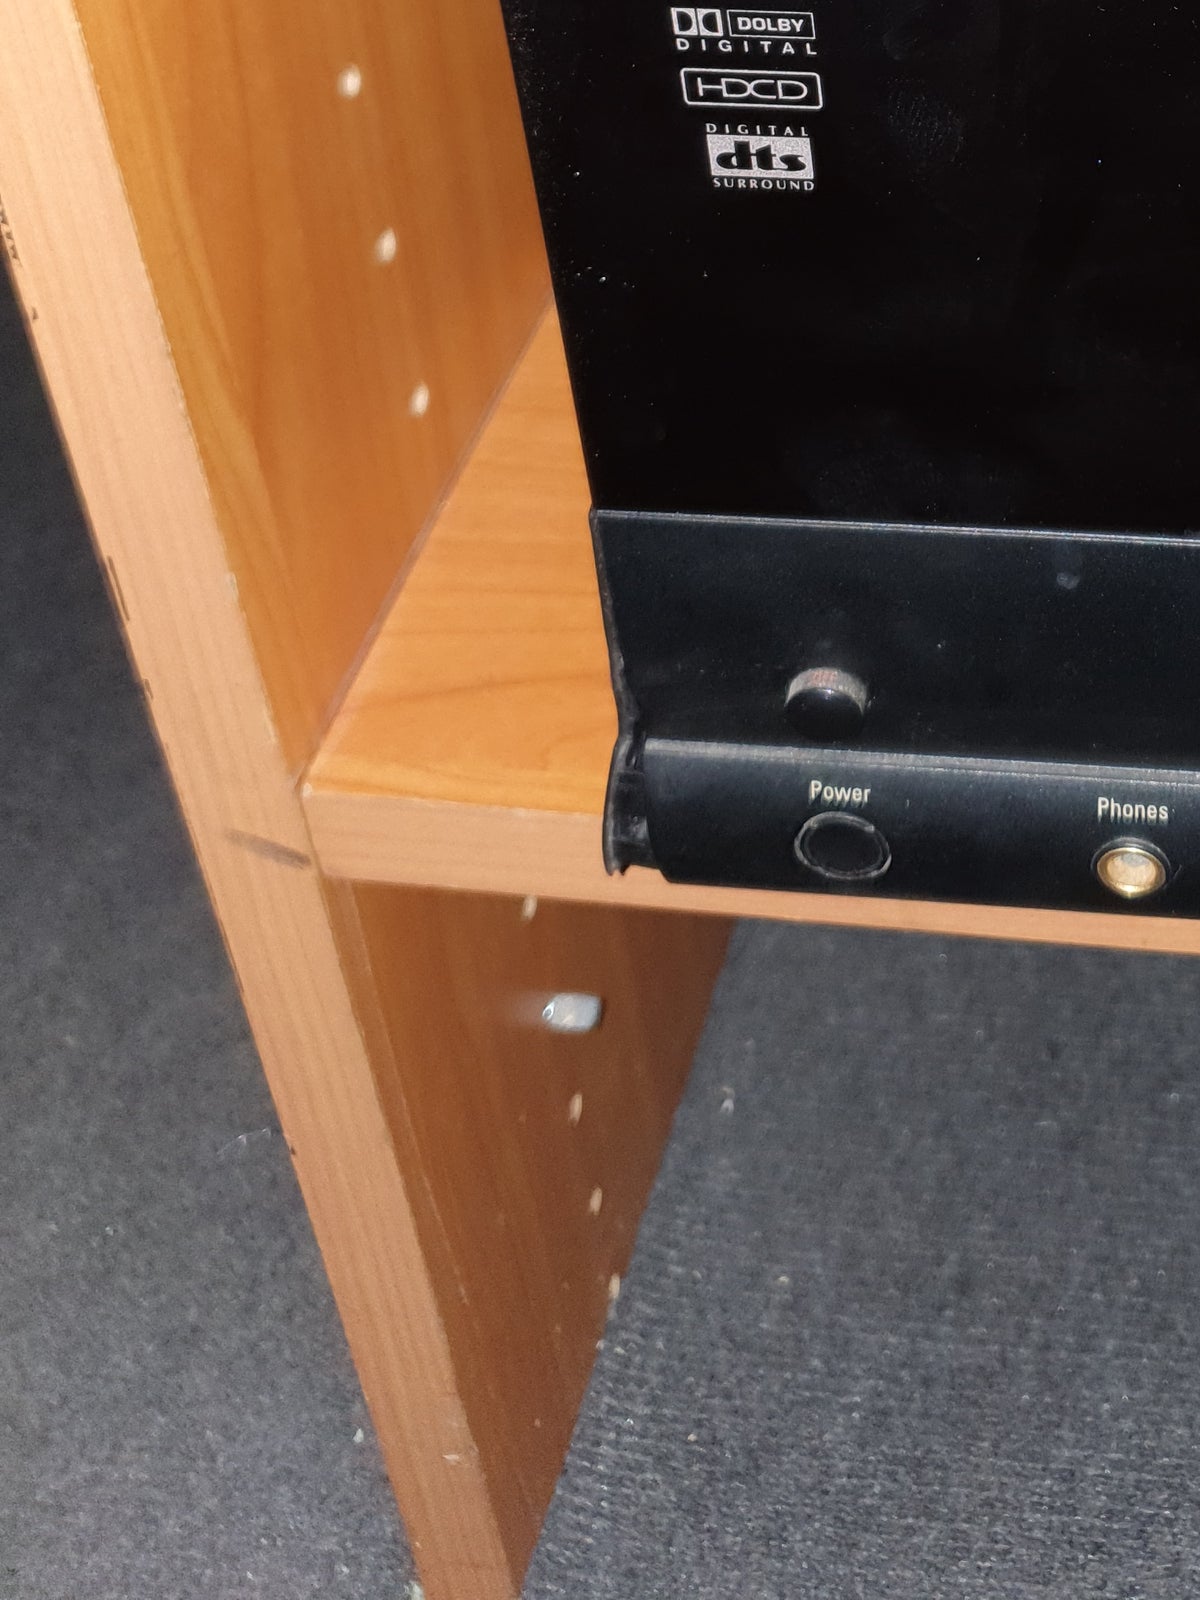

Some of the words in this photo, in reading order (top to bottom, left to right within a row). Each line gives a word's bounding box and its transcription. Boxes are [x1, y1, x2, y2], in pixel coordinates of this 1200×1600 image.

[737, 16, 804, 32] DOLBY
[675, 38, 817, 55] DIGITAL
[697, 77, 808, 100] HDCD
[705, 123, 809, 137] DIGITAL
[715, 140, 807, 172] dts
[712, 177, 815, 191] SURROUND
[809, 779, 871, 805] Power
[1097, 797, 1169, 821] Phones
